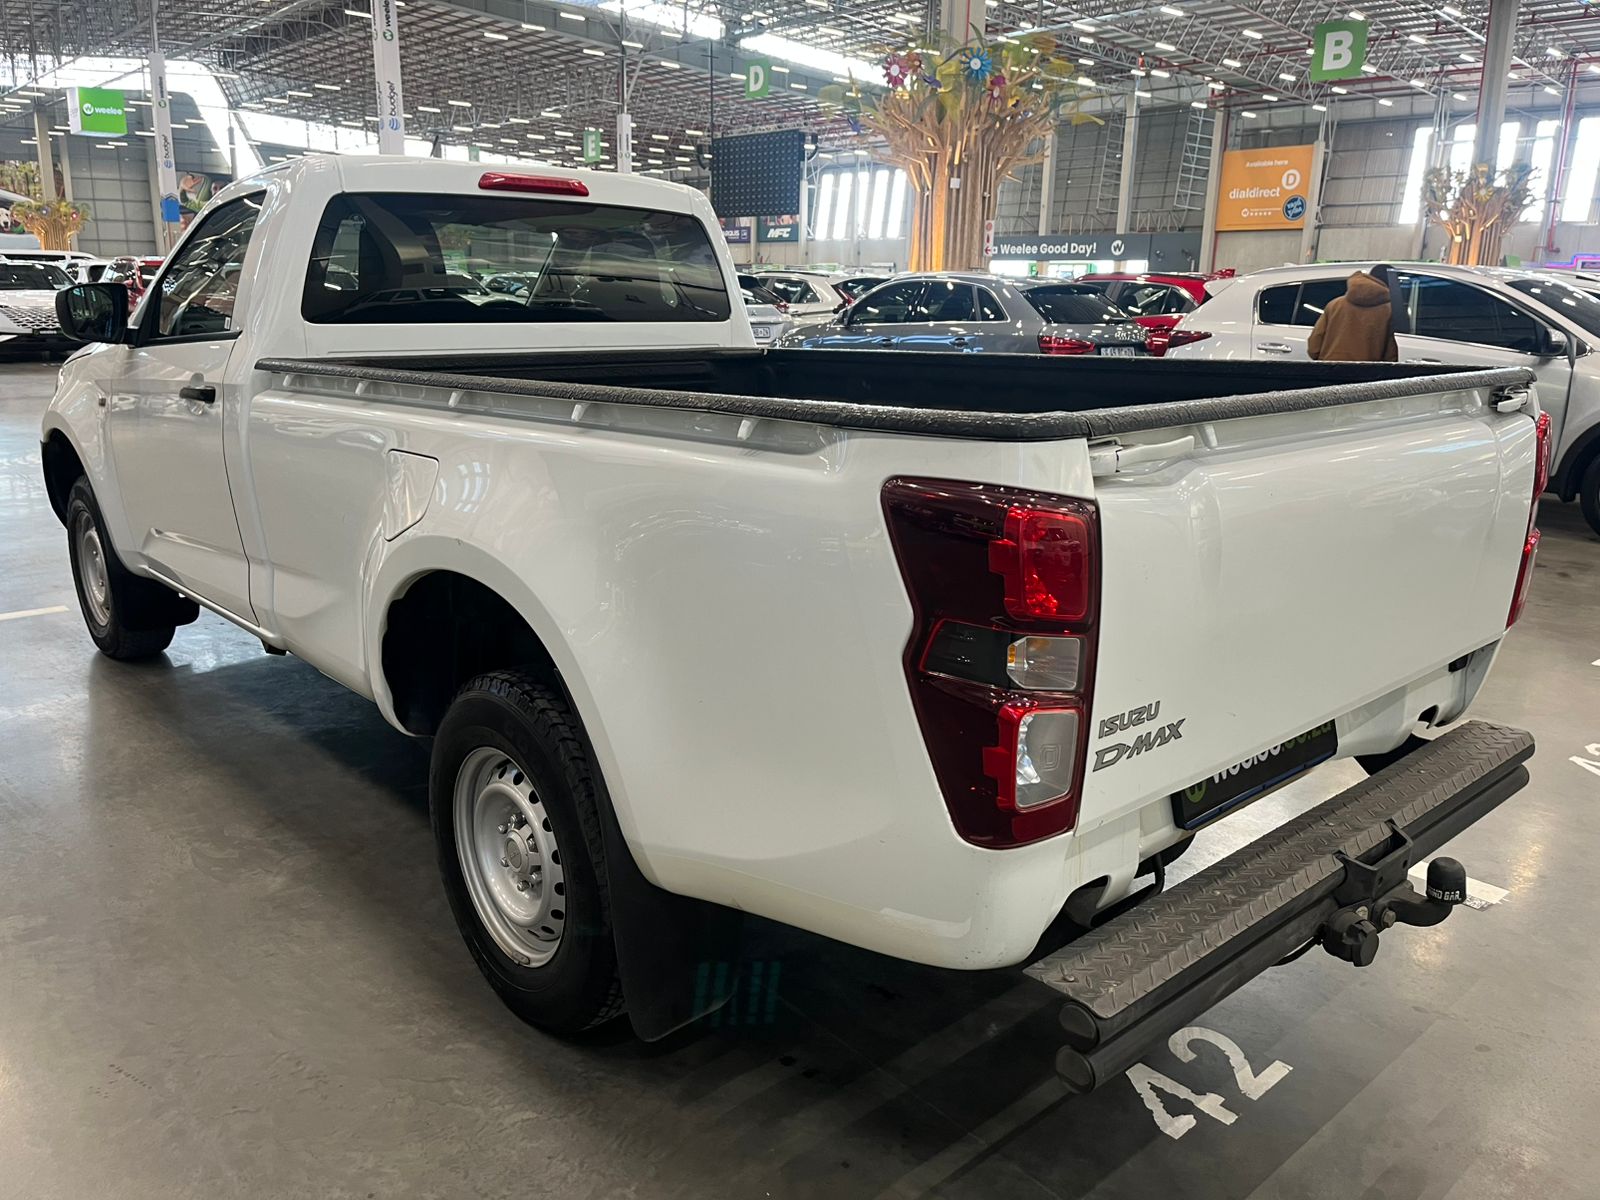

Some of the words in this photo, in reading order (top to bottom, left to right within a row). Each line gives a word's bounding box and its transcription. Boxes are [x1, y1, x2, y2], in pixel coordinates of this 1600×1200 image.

[1322, 30, 1354, 71] B
[749, 65, 764, 92] D
[387, 80, 398, 116] budget
[95, 107, 122, 115] weelee
[162, 134, 170, 158] budget
[588, 134, 596, 157] E
[1229, 187, 1280, 199] dialdirect
[767, 227, 791, 238] MFC
[1000, 243, 1038, 255] Weelee
[1039, 243, 1068, 255] Good
[1070, 242, 1097, 257] Day!
[1098, 700, 1160, 739] ISUZU
[1092, 718, 1186, 772] D-MAX
[1125, 1026, 1294, 1140] 42
